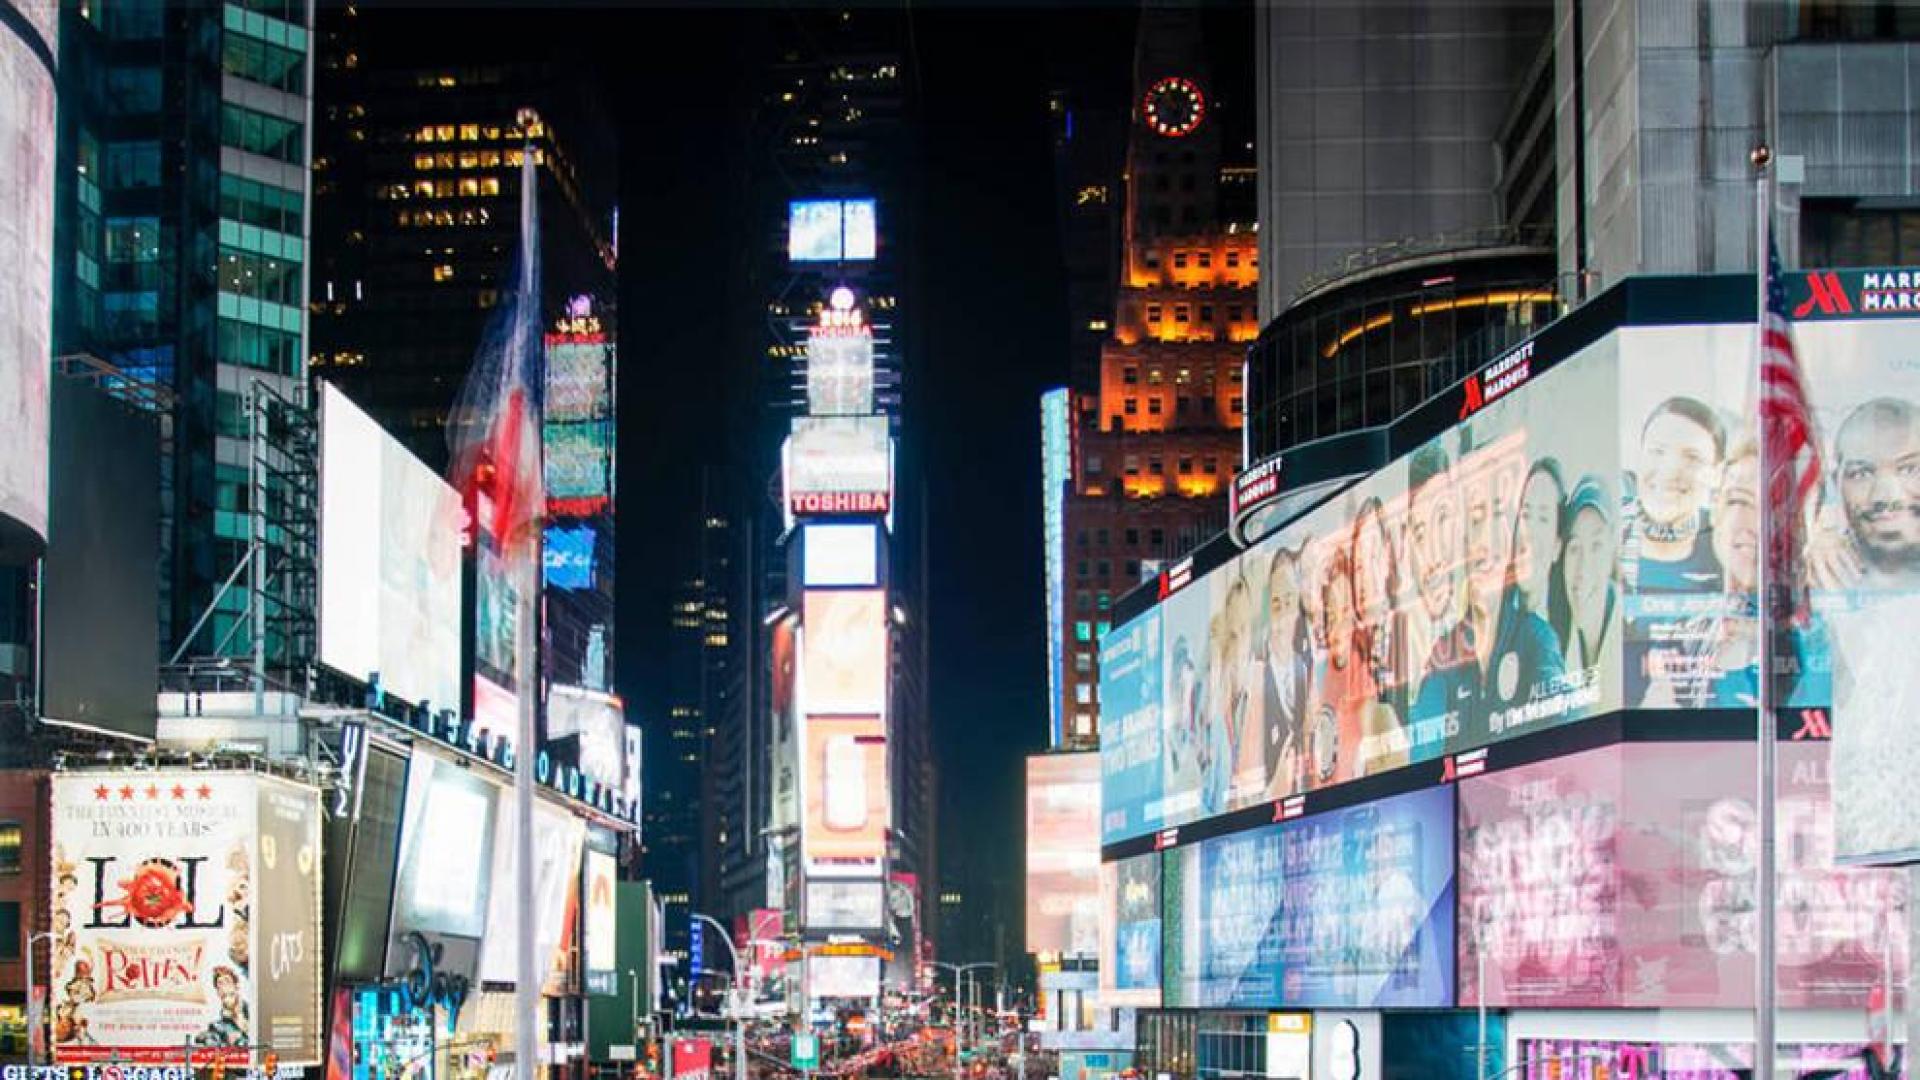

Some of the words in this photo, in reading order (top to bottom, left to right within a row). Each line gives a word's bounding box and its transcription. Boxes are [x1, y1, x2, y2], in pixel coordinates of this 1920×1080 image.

[1484, 341, 1535, 382] MARRIOTT
[1484, 361, 1529, 403] MARQUIS
[791, 493, 888, 512] TOSHIBA
[92, 821, 111, 837] IN
[270, 929, 304, 981] CATS
[3, 1065, 67, 1080] GIFTS
[87, 1065, 191, 1080] LGGAGE
